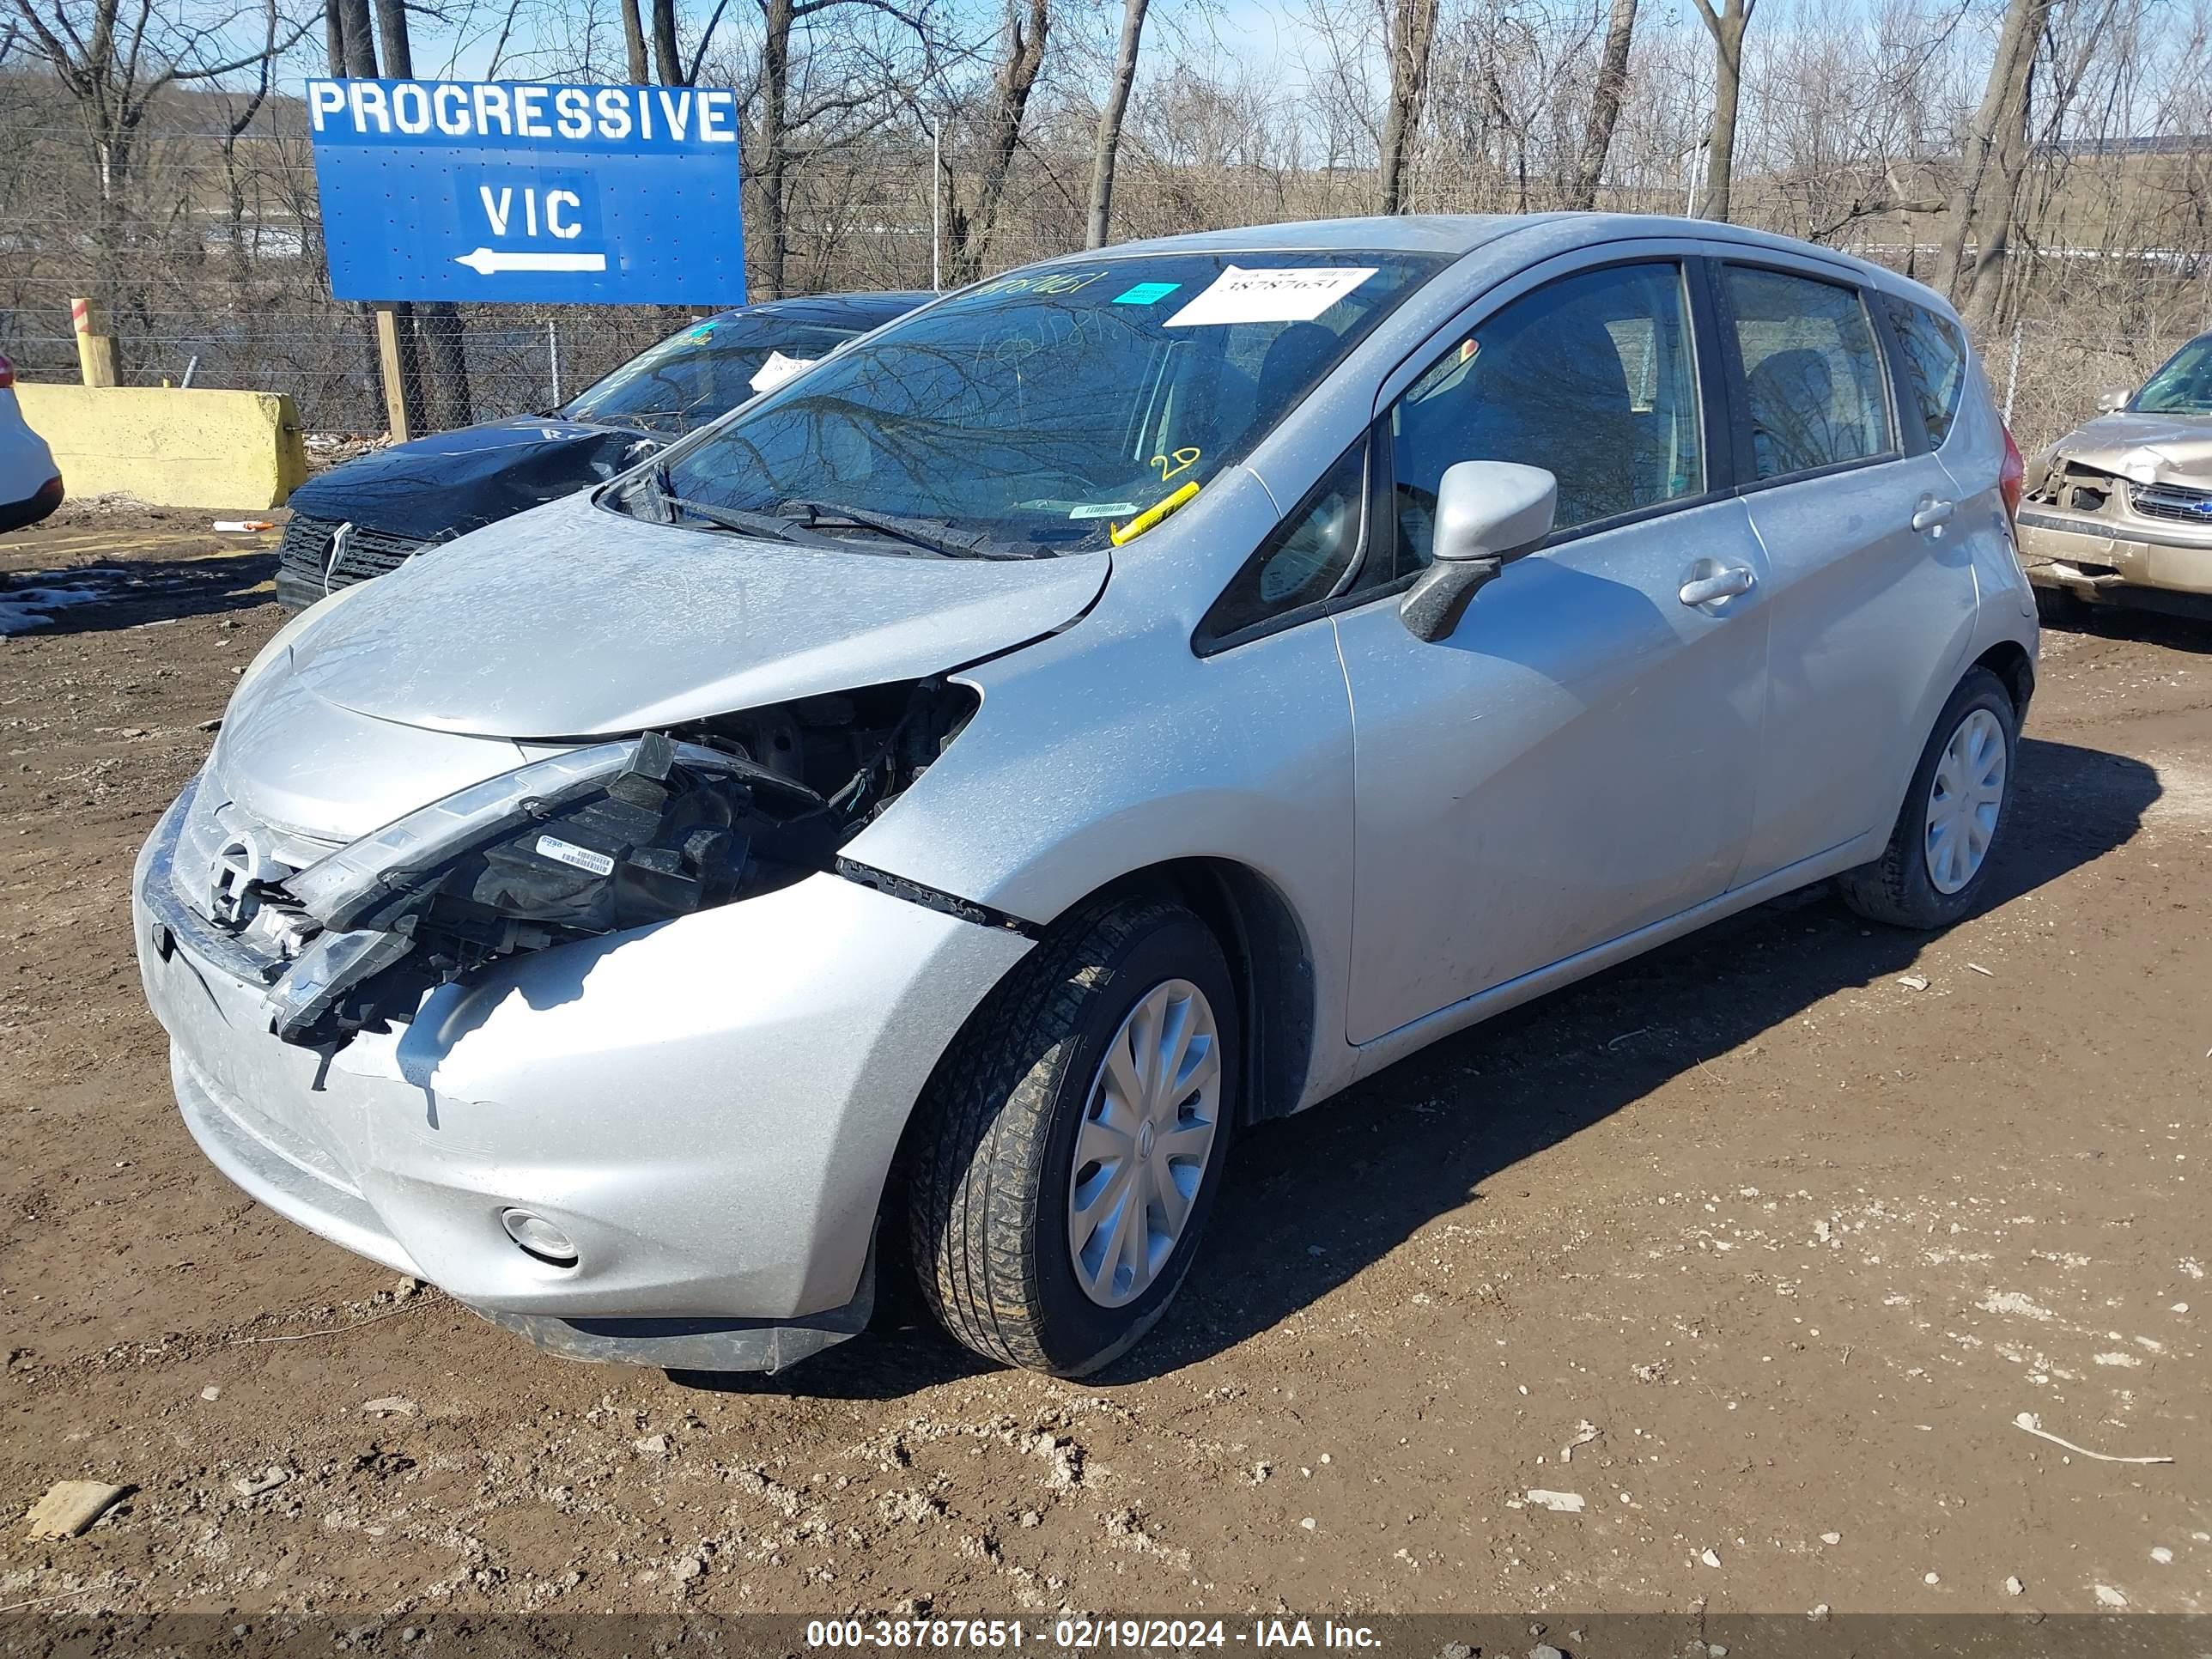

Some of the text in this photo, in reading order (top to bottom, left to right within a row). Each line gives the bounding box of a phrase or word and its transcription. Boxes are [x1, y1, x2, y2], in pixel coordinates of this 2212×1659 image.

[308, 82, 736, 142] PROGRESSIVE
[479, 186, 582, 239] VIC
[1151, 447, 1200, 482] 20
